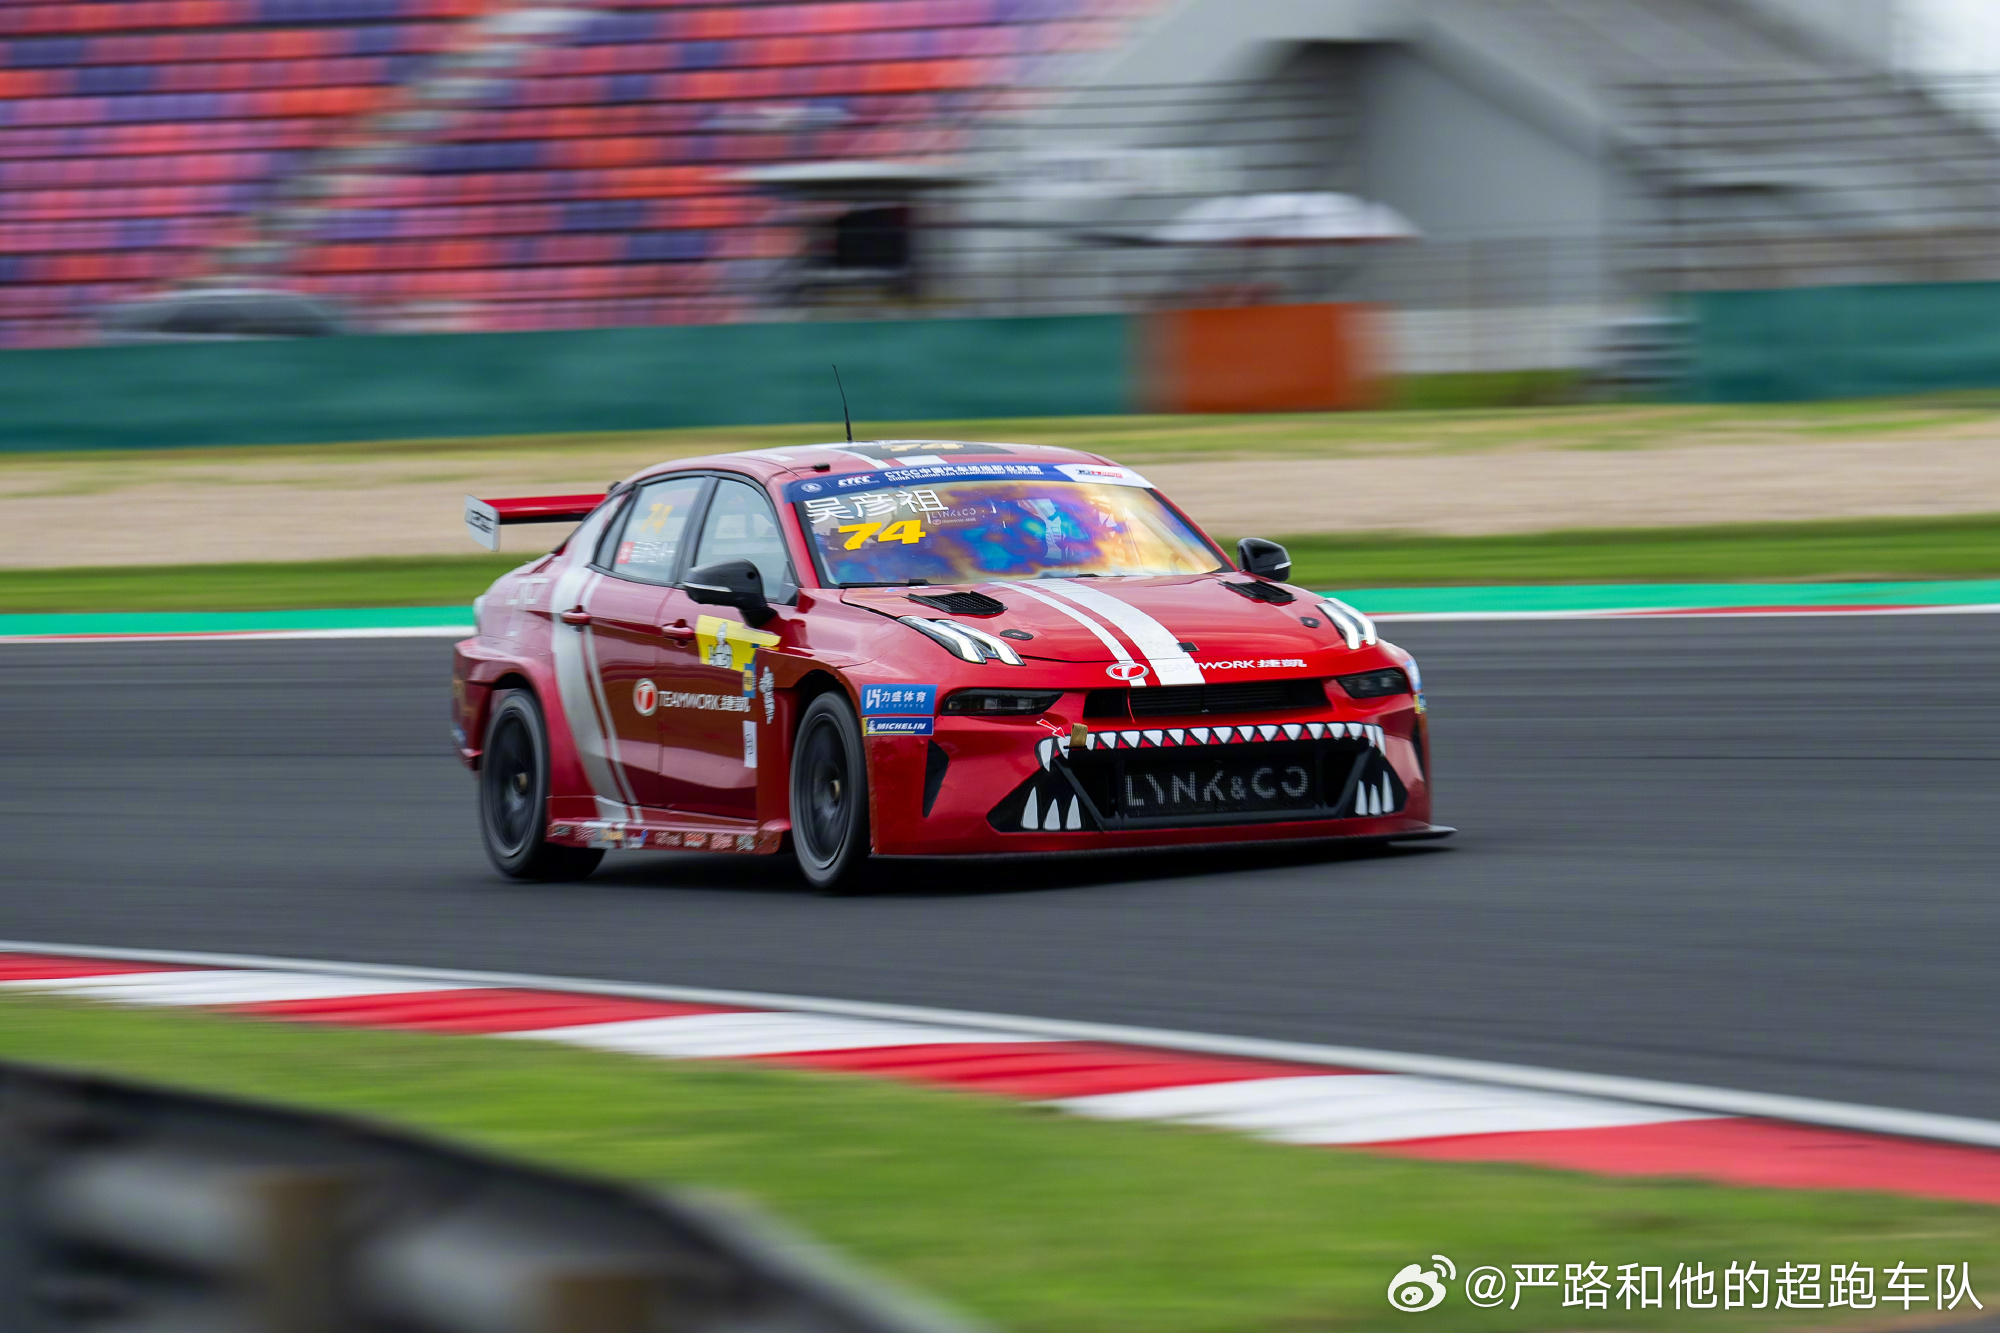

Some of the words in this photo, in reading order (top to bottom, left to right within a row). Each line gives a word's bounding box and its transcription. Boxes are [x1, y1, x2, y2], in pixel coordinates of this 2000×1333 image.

[804, 489, 949, 524] 吴彦祖
[837, 519, 926, 551] 74
[658, 690, 719, 711] TEAMWORK
[881, 690, 927, 703] 力盛体育
[876, 722, 927, 730] MICHELIN
